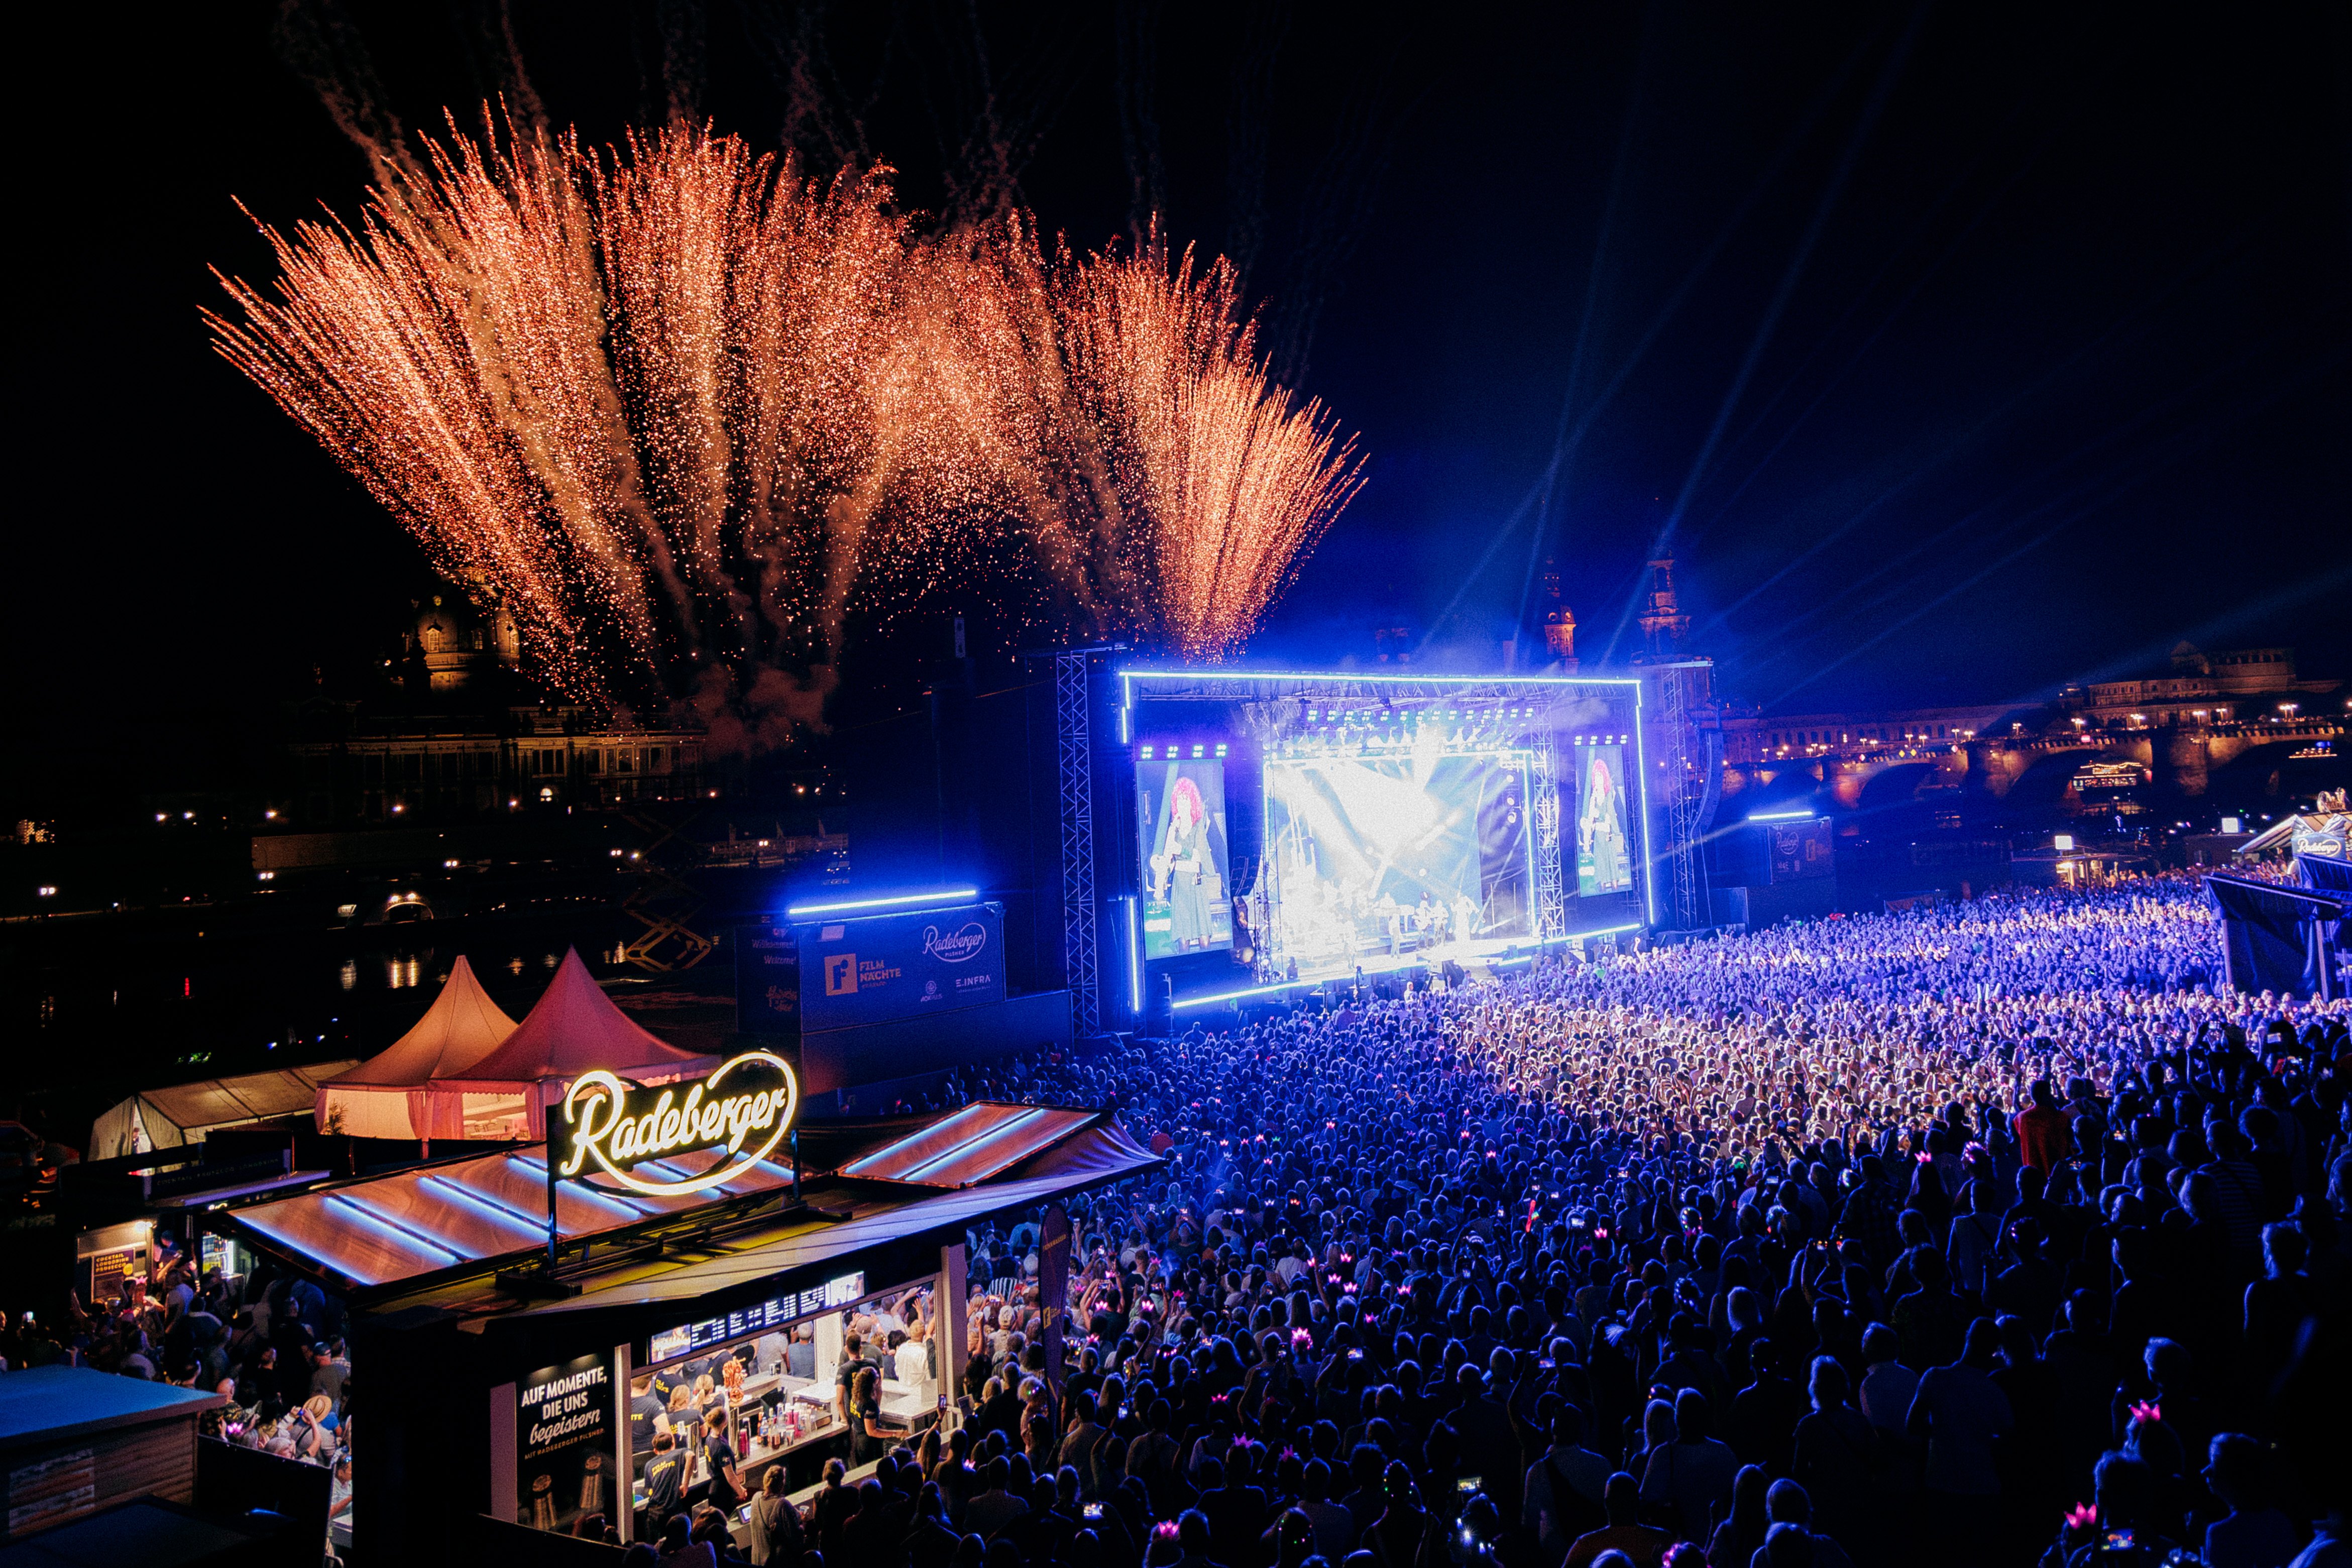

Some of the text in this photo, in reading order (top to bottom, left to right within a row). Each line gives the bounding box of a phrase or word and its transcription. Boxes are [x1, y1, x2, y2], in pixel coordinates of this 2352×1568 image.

[922, 922, 986, 963] Radeberger
[859, 959, 884, 972] FILM
[561, 1052, 798, 1196] Radeberger
[521, 1366, 608, 1407] AUF MOMENTE,
[542, 1391, 589, 1420] DIE UNS
[529, 1408, 601, 1445] begeistern
